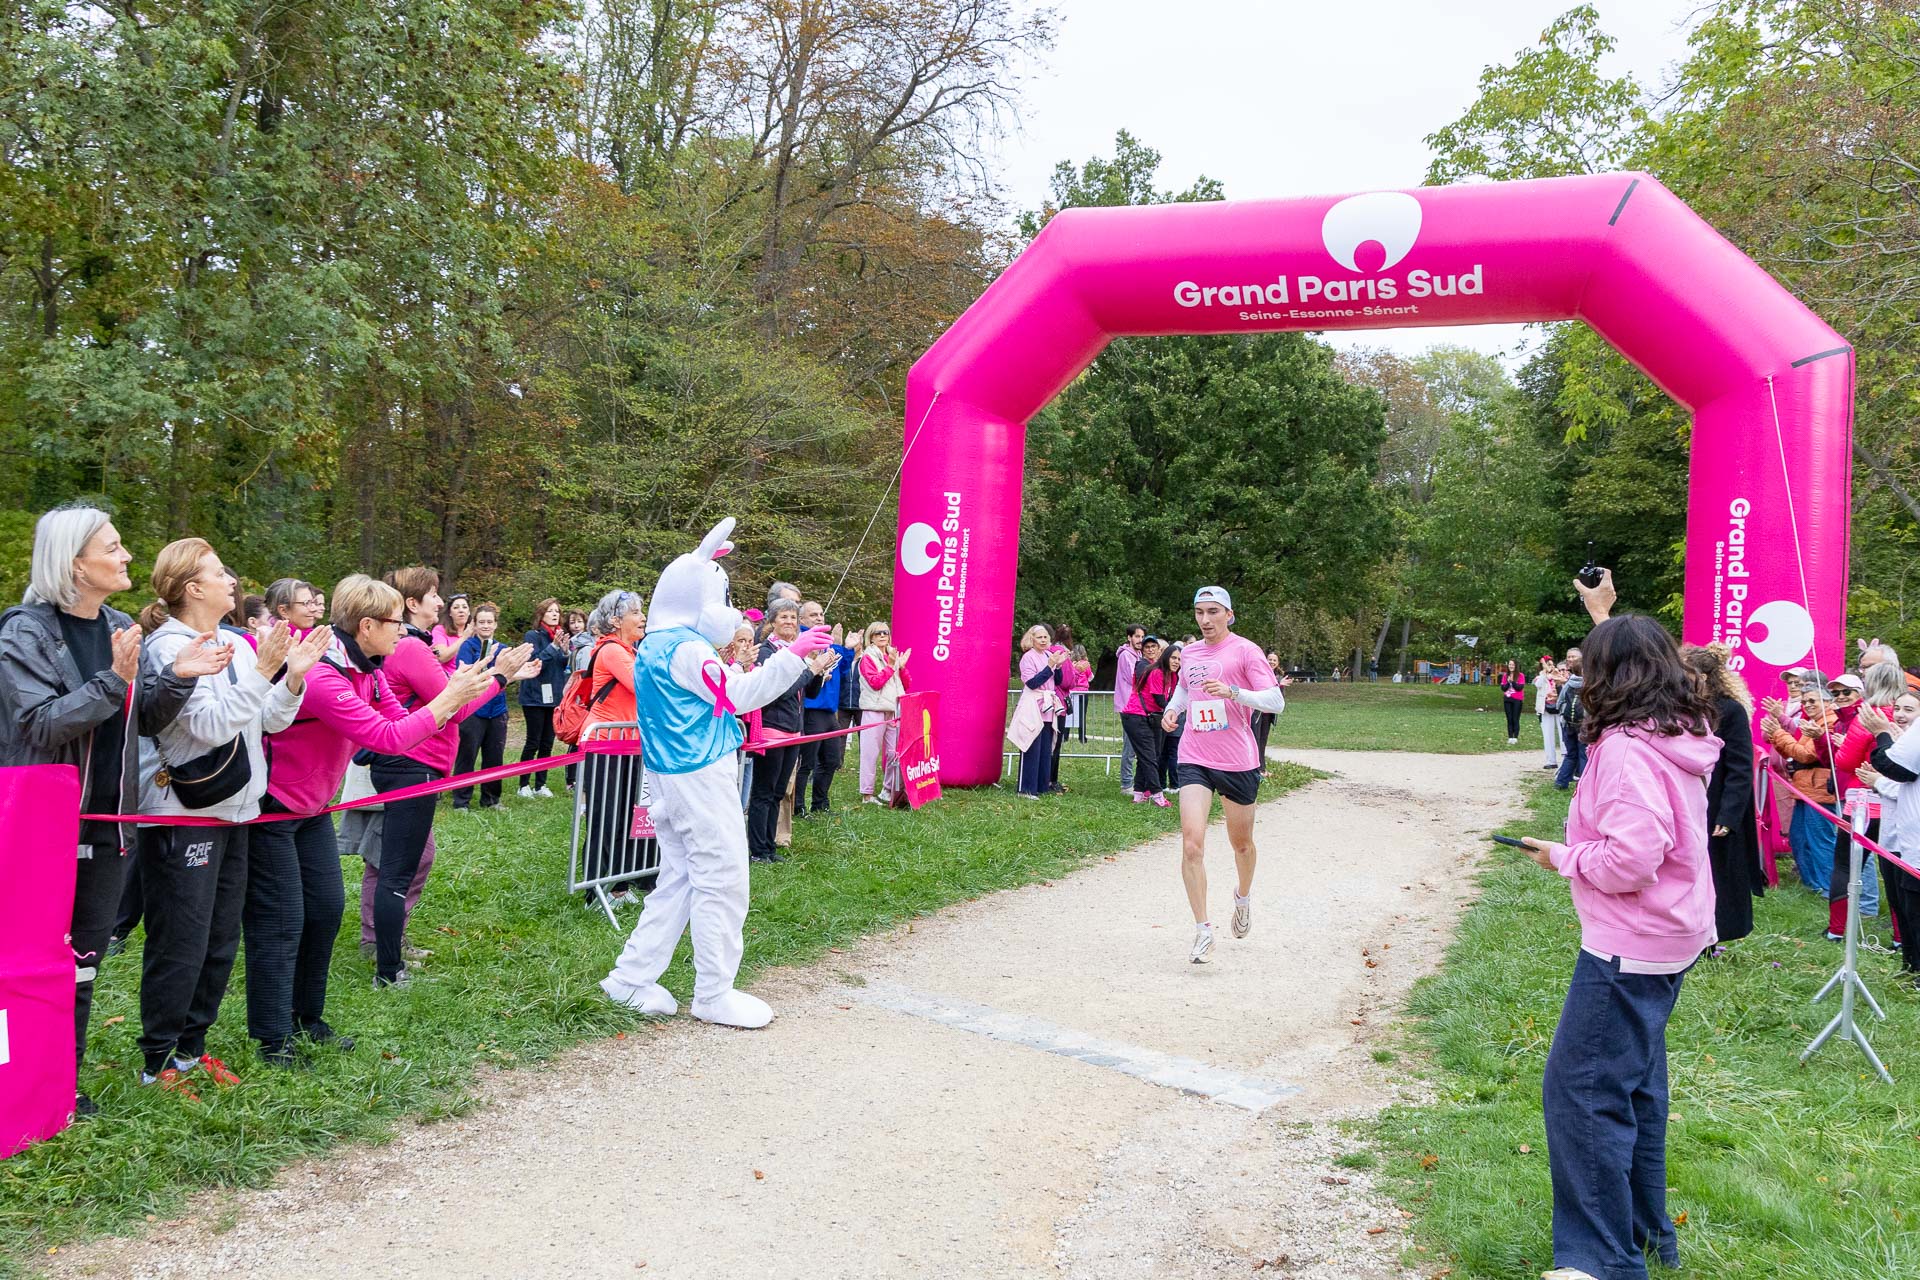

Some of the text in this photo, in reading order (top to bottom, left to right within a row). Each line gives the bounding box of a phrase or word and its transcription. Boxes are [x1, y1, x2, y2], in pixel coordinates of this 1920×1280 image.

[1173, 264, 1484, 308] Grand Paris Sud
[1239, 304, 1419, 321] Seine-Essonne-Sénart
[932, 491, 962, 661] Grand Paris Sud
[955, 527, 971, 628] Seine-Essonne-Sénart
[1725, 497, 1751, 677] Grand Paris S
[1199, 708, 1217, 723] 11
